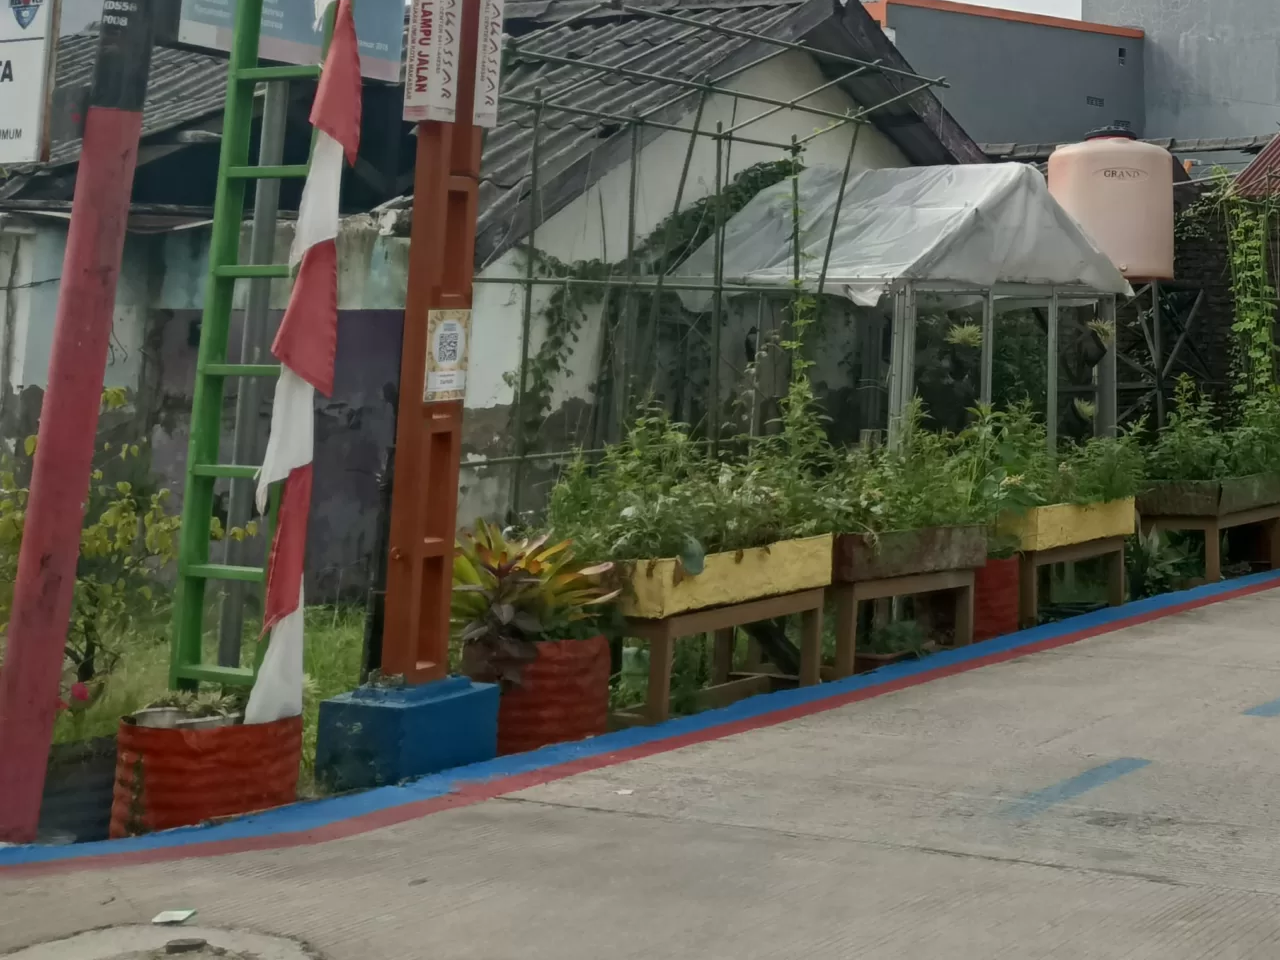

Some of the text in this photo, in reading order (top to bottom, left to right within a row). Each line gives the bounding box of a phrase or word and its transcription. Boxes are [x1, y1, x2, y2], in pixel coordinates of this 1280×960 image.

[418, 1, 434, 47] LAMPU
[414, 49, 430, 93] JALAN
[1103, 170, 1140, 178] GRAND
